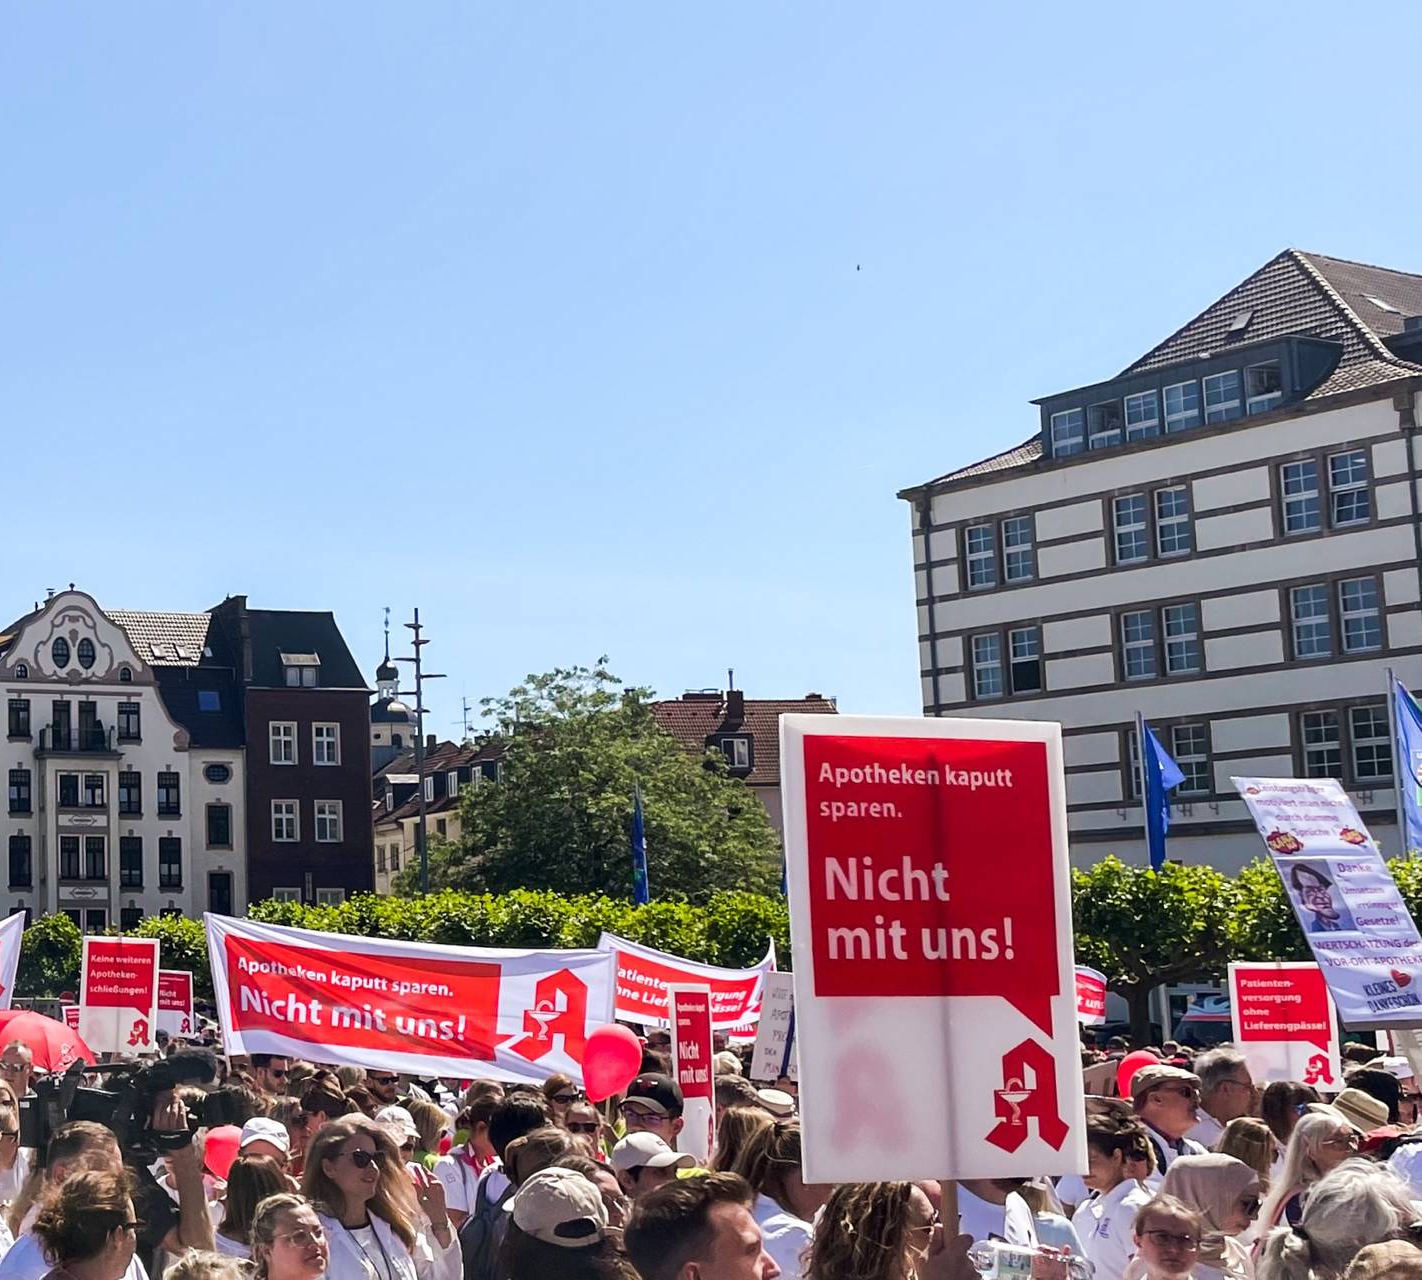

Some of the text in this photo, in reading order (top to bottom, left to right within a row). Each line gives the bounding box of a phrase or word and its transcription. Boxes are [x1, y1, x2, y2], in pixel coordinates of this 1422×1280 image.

[819, 762, 1013, 791] Apotheken kaputt
[819, 801, 902, 822] sparen.
[825, 856, 950, 901] Nicht
[828, 915, 1015, 961] mit uns!
[91, 954, 152, 965] Keine weiteren
[90, 969, 139, 979] Apotheken-
[238, 956, 454, 997] Apotheken kaputt sparen.
[1240, 979, 1294, 988] Patienten-
[89, 985, 148, 996] schließungen!
[616, 982, 640, 1001] hne
[1241, 994, 1301, 1004] versorgung
[239, 985, 467, 1042] Nicht mit uns!
[1242, 1007, 1269, 1016] ohne
[1243, 1020, 1327, 1032] Lieferengpässe!
[679, 1040, 700, 1059] Nicht
[680, 1063, 709, 1084] mit uns!
